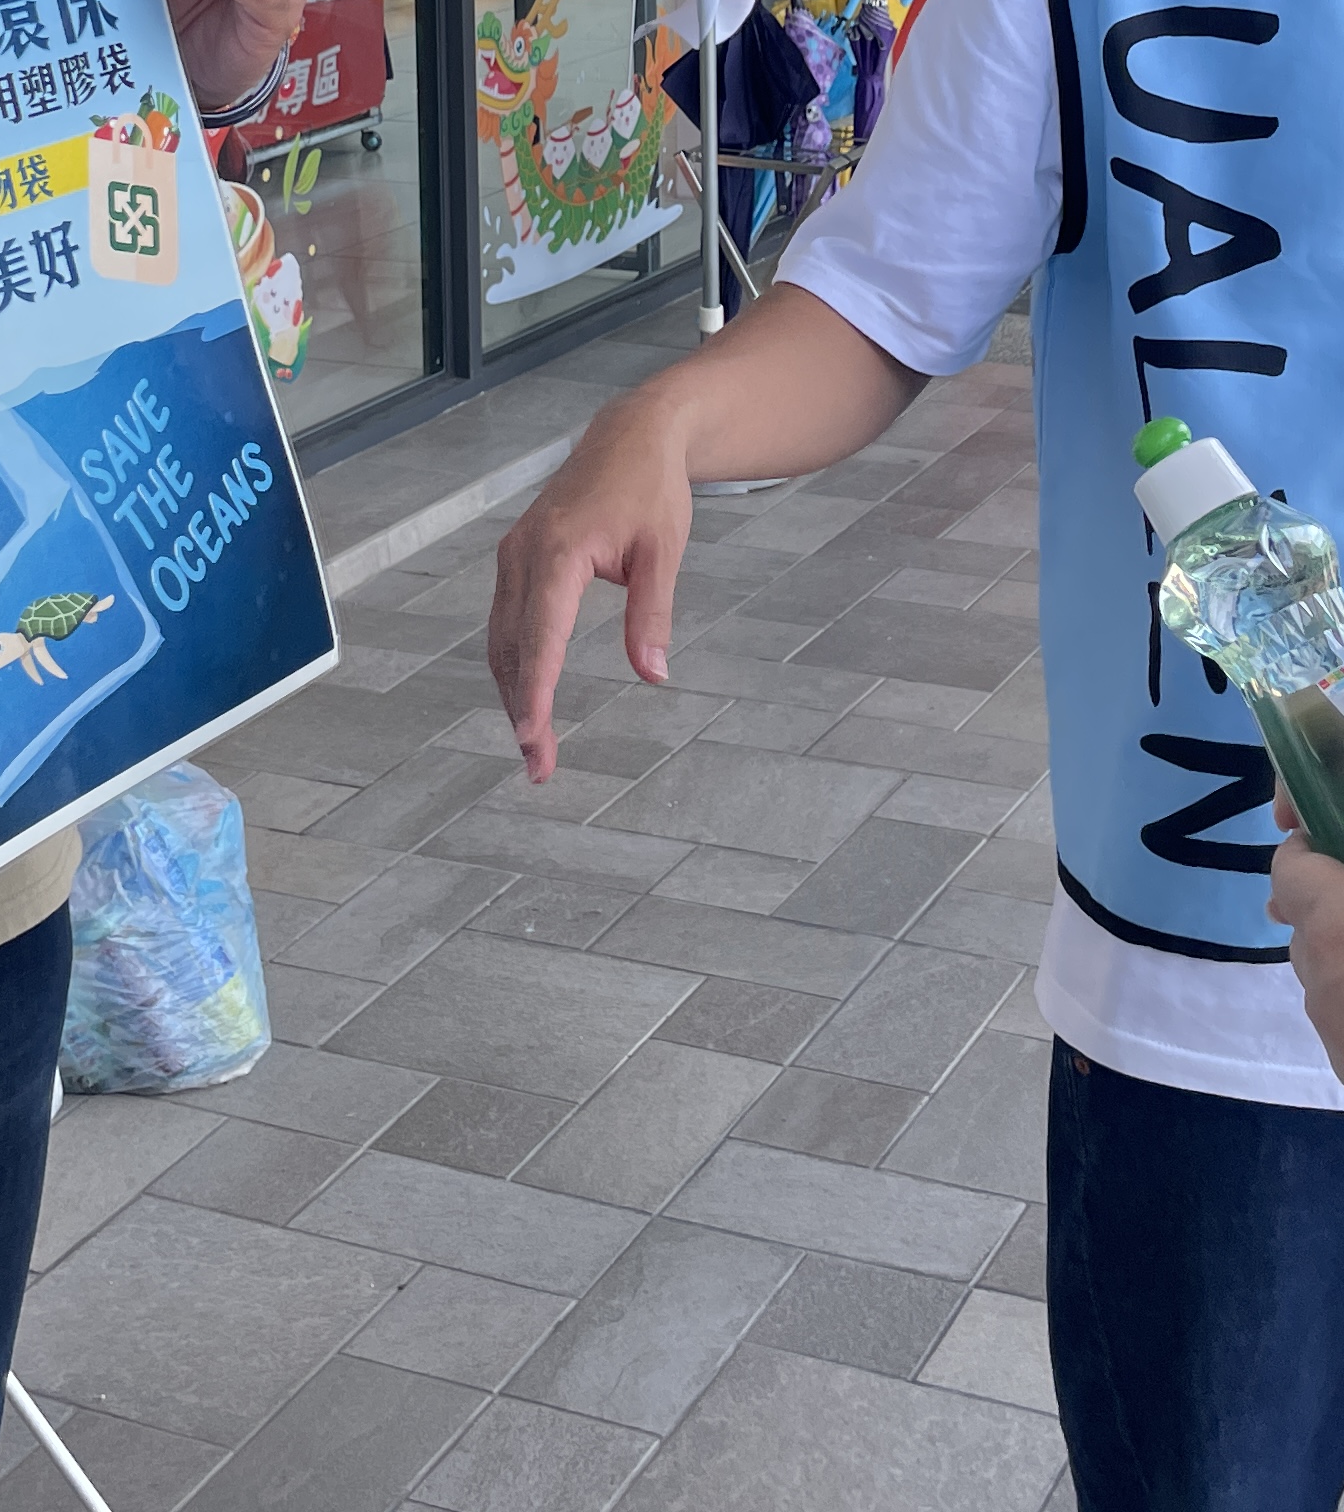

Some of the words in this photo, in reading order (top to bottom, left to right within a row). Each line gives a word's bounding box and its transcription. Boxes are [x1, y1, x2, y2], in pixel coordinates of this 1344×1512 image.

[256, 44, 341, 124] 專區
[80, 378, 171, 506] SAVE
[113, 443, 194, 551] THE
[150, 442, 274, 613] OCEANS
